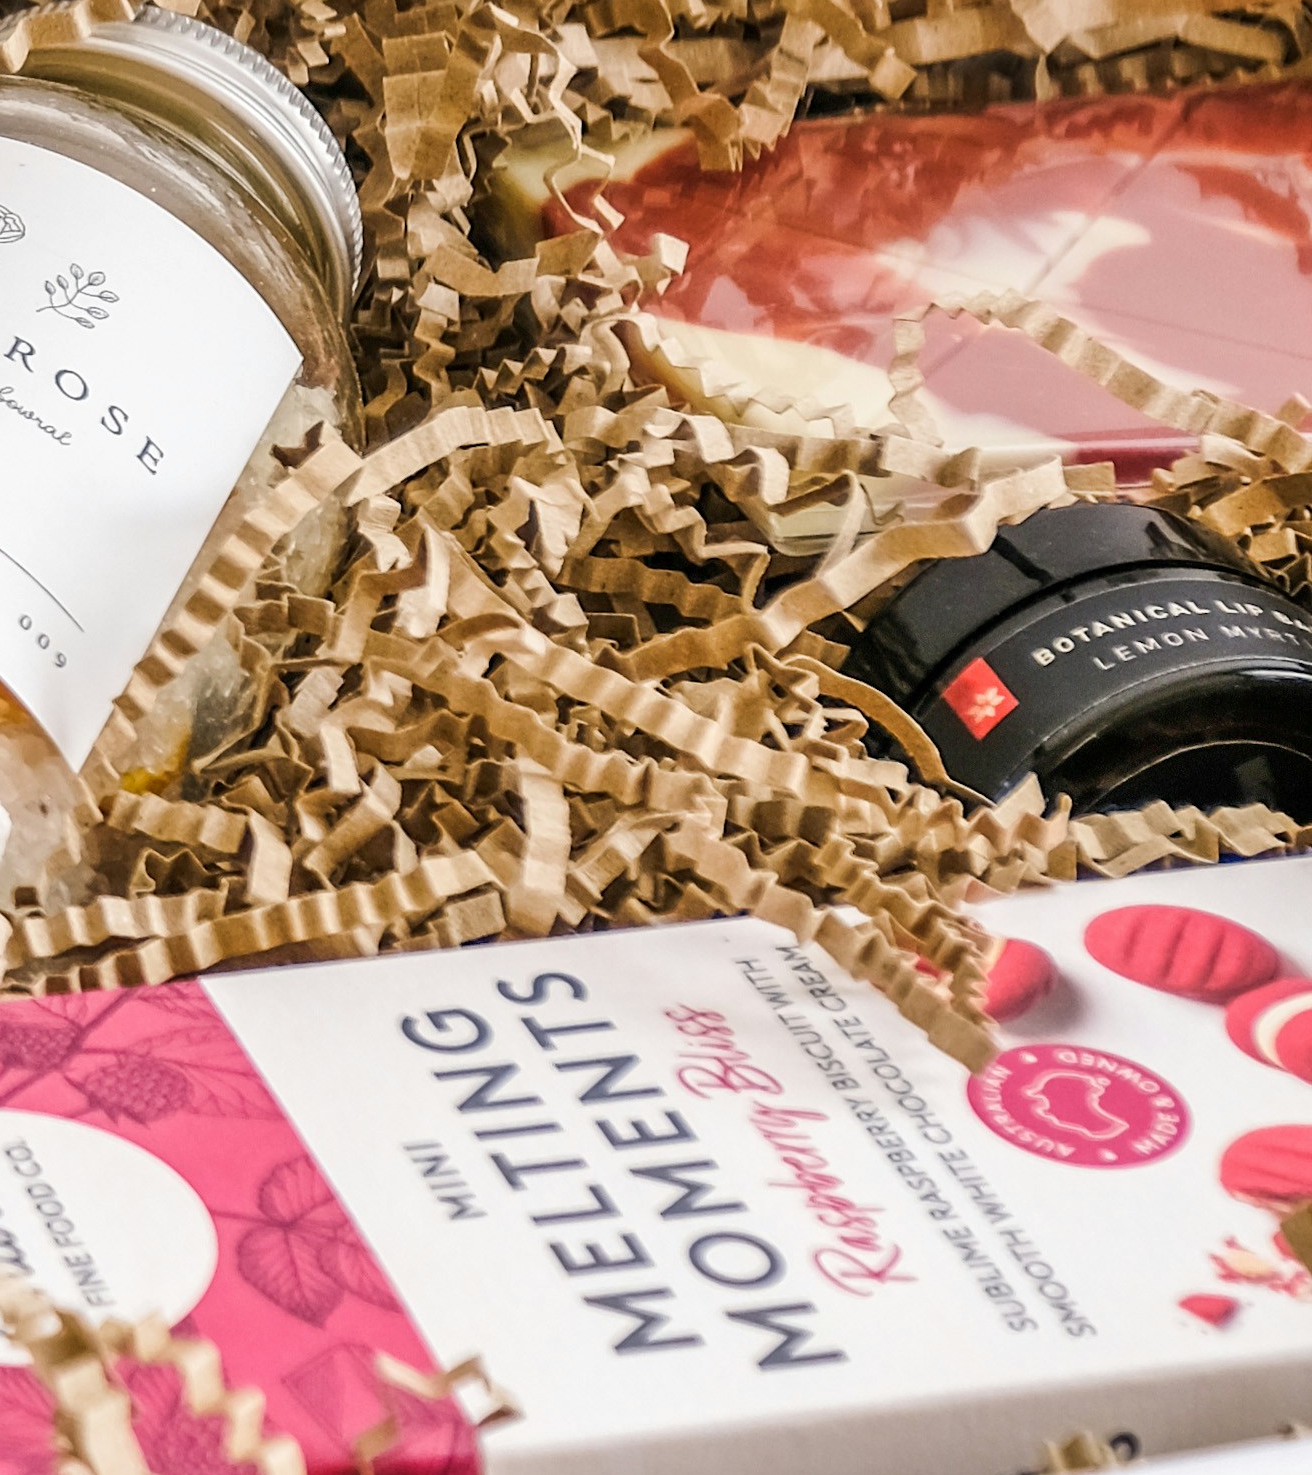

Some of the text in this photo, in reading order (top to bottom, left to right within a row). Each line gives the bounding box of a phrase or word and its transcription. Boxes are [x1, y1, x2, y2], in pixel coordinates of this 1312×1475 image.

[4, 336, 164, 476] ROSE
[1030, 599, 1212, 669] BOTANICAL
[1213, 599, 1264, 617] LIP
[1092, 627, 1210, 670] LEMON
[775, 944, 848, 1012] CREAM
[832, 1015, 954, 1145] CHOCOLATE
[982, 1064, 1076, 1159] AUSTRALIAN
[1054, 1049, 1161, 1094] OWNED
[495, 971, 851, 1371] MOMENTS
[663, 1003, 920, 1298] Raspberry Bliss
[734, 957, 1040, 1334] SUBLIME RASPBERRY BISCUIT WITH
[1132, 1112, 1181, 1155] MADE
[26, 1181, 84, 1249] FOOD
[400, 1007, 706, 1355] MELTING
[401, 1140, 488, 1221] MINI
[938, 1146, 1014, 1226] WHITE
[63, 1251, 118, 1308] FINE
[998, 1227, 1097, 1339] SMOOTH
